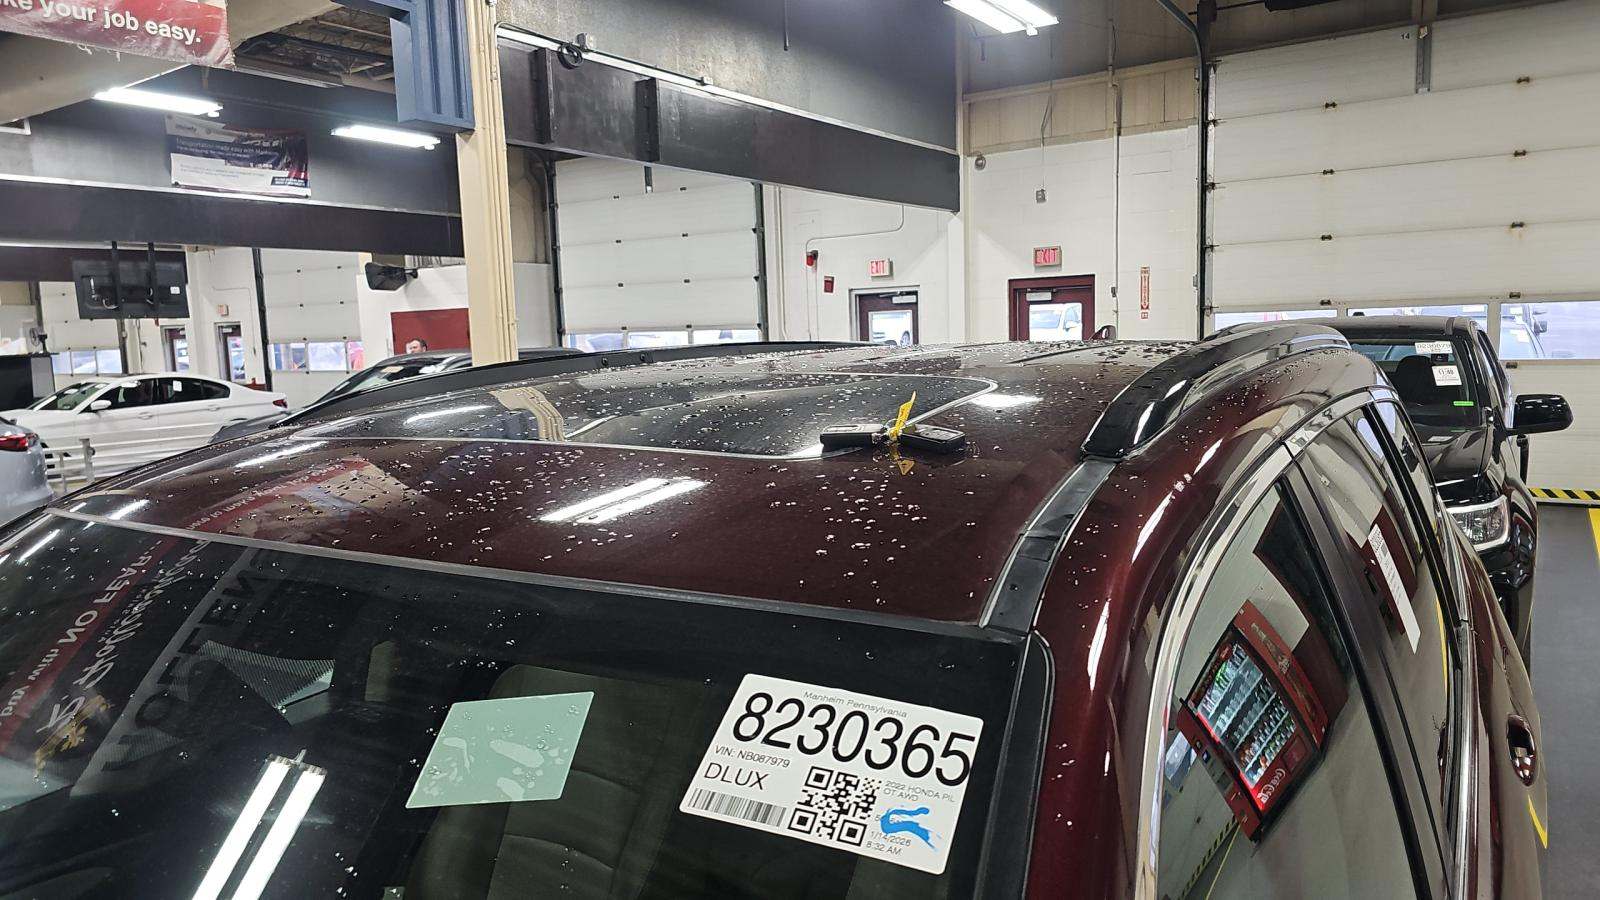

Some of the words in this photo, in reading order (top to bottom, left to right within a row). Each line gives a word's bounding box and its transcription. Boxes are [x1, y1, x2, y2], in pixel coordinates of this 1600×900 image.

[39, 0, 97, 22] your
[103, 7, 140, 31] job
[145, 20, 202, 45] easy.
[1400, 32, 1410, 40] 14
[1035, 248, 1058, 264] EXIT
[870, 259, 886, 275] EXIT
[803, 691, 845, 705] Manheim
[846, 699, 908, 718] Pennsylvania
[733, 692, 976, 787] 8230365
[714, 745, 735, 757] VIN:
[737, 750, 791, 768] NB087979
[704, 762, 769, 791] DLUX
[885, 781, 906, 791] 2022
[908, 785, 940, 799] HONDA
[897, 791, 919, 802] AWD
[886, 846, 902, 855] AM
